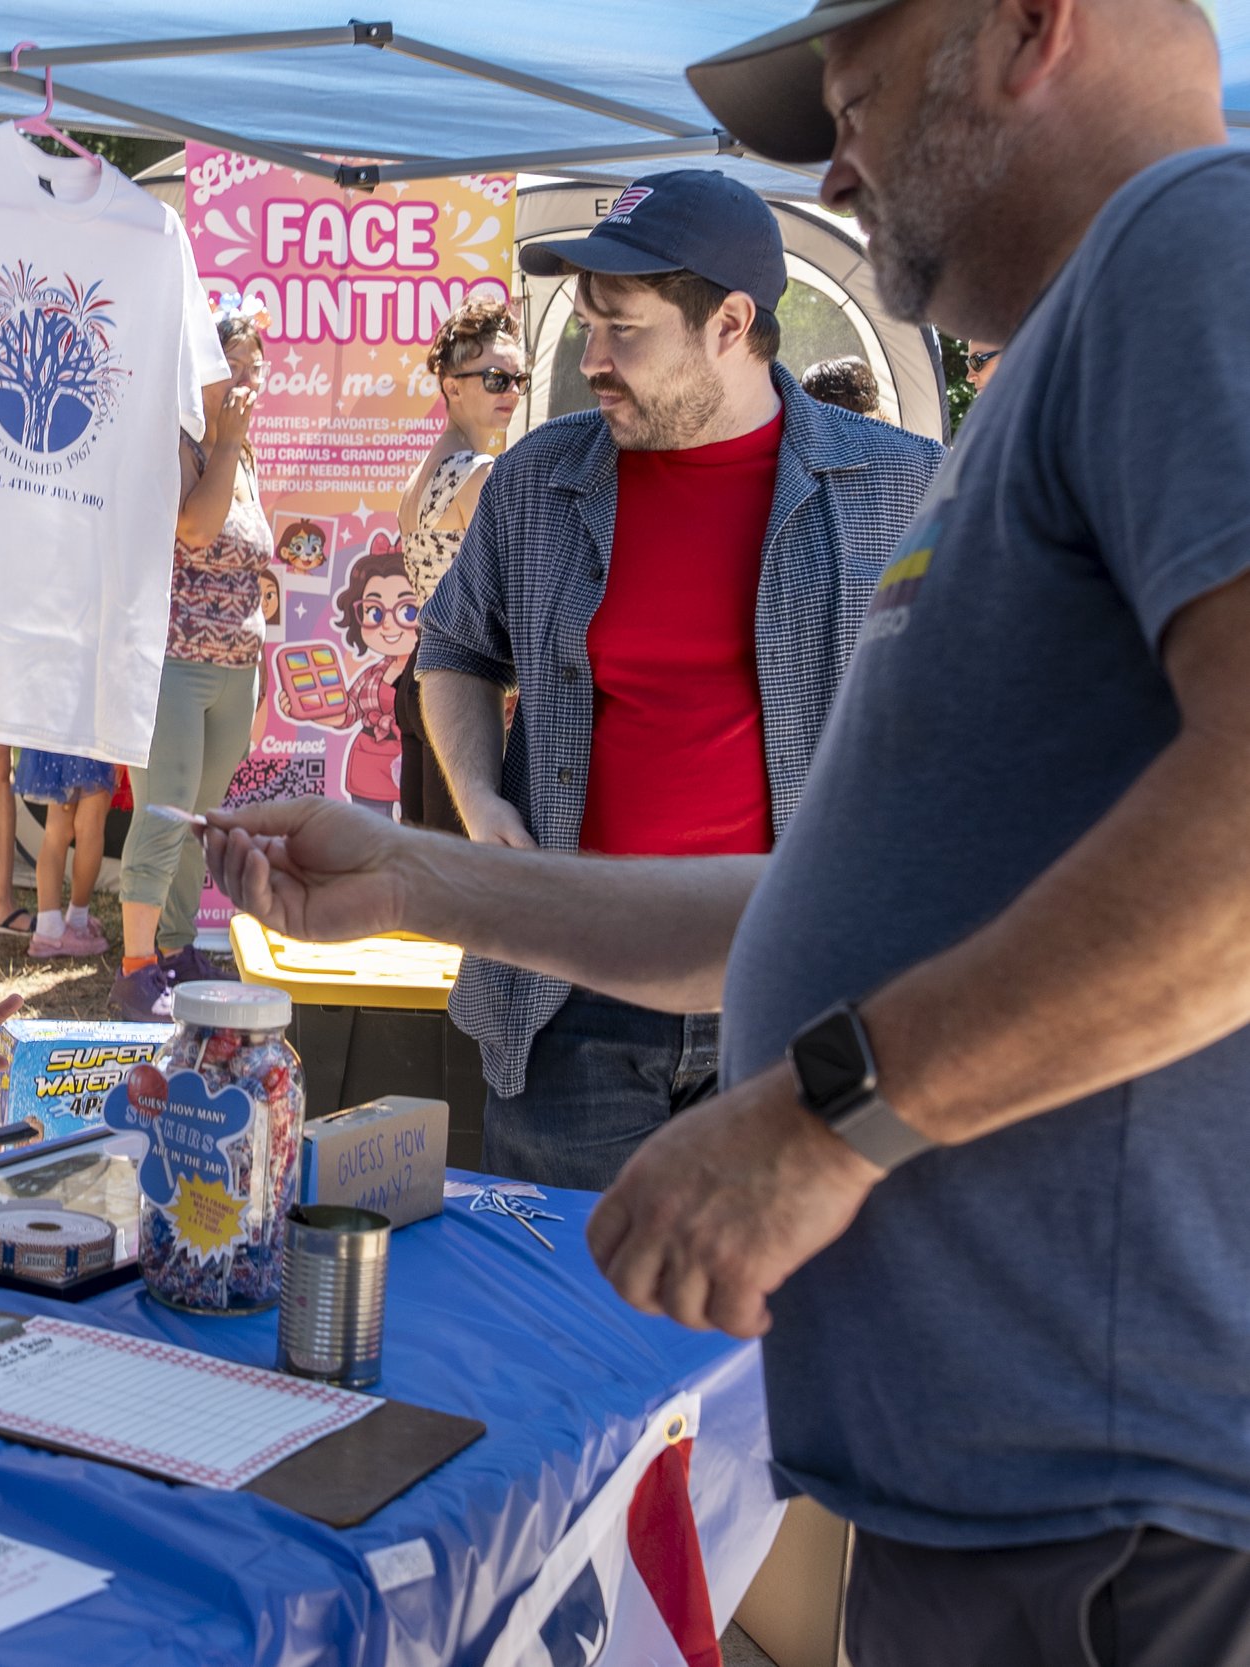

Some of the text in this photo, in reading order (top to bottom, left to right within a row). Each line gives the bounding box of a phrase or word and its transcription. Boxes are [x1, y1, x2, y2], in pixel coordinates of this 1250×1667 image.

[263, 200, 437, 269] FACE
[259, 363, 441, 397] ook me fo
[257, 416, 310, 430] PARTIES
[318, 417, 389, 430] PLAYDATES
[398, 418, 444, 431] FAMILY
[254, 432, 441, 446] FAIRS FESTIVALS CORPORAT
[66, 440, 92, 470] 1967
[254, 447, 276, 460] UB
[278, 448, 330, 461] CRAWLS
[341, 448, 385, 461] GRAND
[275, 463, 307, 476] THAT
[310, 464, 350, 477] NEEDS
[351, 464, 361, 477] A
[364, 464, 405, 477] TOUCH
[51, 486, 81, 502] JULY
[257, 479, 313, 493] ENEROUS
[314, 479, 375, 493] SPRINKLE
[378, 480, 394, 493] OF
[261, 735, 327, 754] Connect
[46, 1044, 155, 1072] SUPER
[34, 1070, 121, 1098] WATER
[138, 1095, 227, 1125] GUESS HOW MANY
[125, 1104, 215, 1154] SUCKERS
[152, 1144, 227, 1177] ARE IN THE JAR?
[338, 1122, 426, 1187] GUESS HOW
